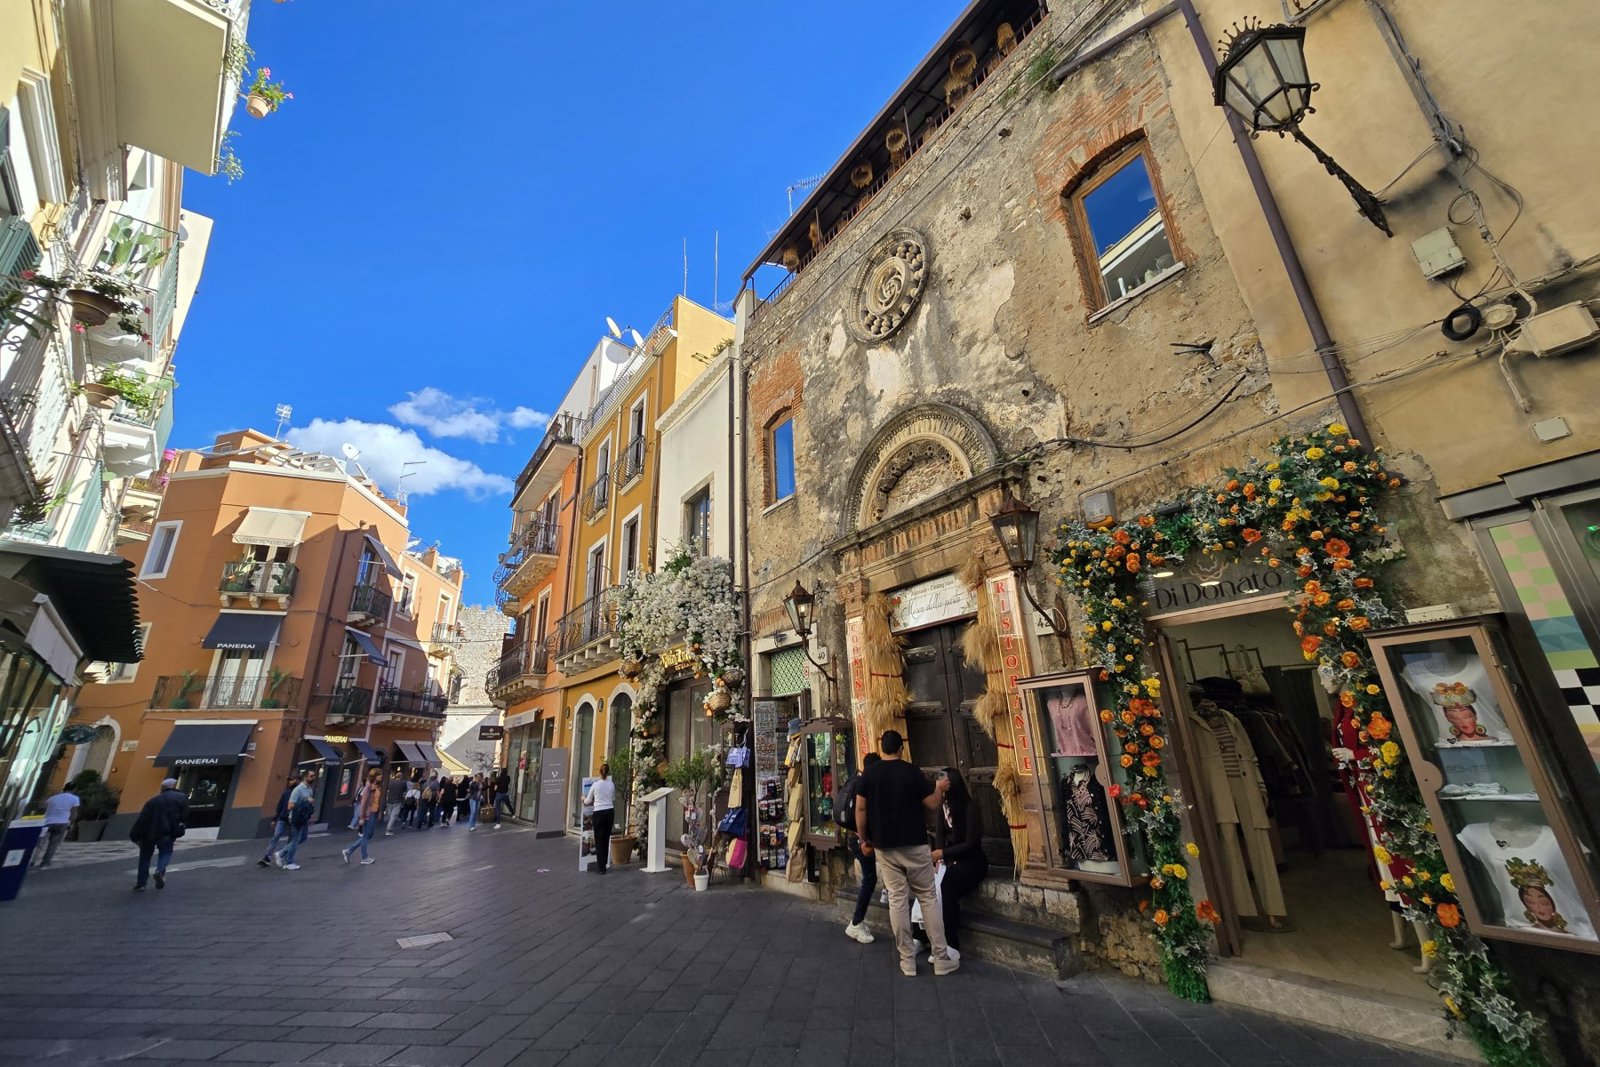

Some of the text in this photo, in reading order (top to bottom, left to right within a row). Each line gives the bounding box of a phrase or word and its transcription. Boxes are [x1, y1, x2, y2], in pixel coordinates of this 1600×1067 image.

[1155, 571, 1283, 609] Di Donato
[324, 735, 348, 743] PANERAI
